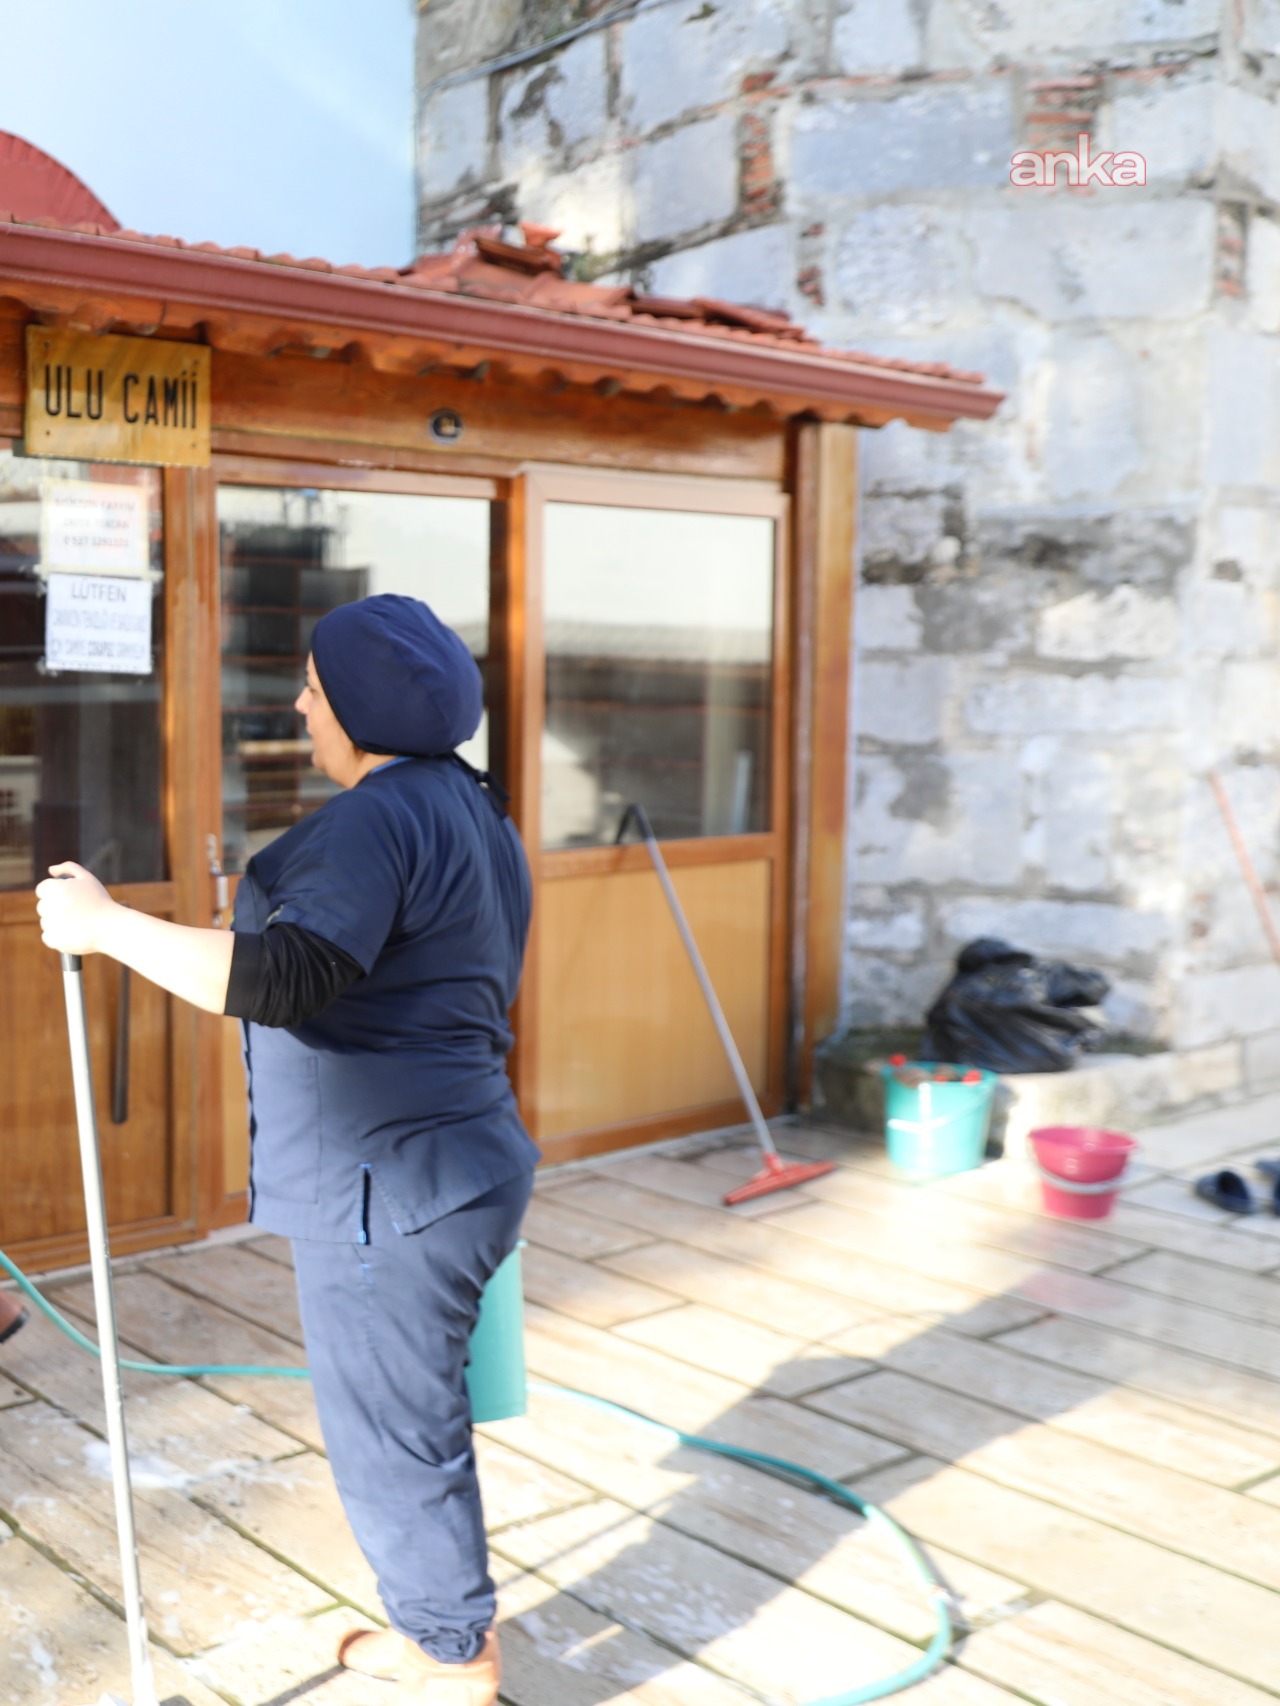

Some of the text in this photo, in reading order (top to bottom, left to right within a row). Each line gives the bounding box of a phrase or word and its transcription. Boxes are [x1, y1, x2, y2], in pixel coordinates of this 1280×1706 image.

[44, 364, 198, 429] ULU CAMİİ
[71, 577, 127, 602] LÜTFEN
